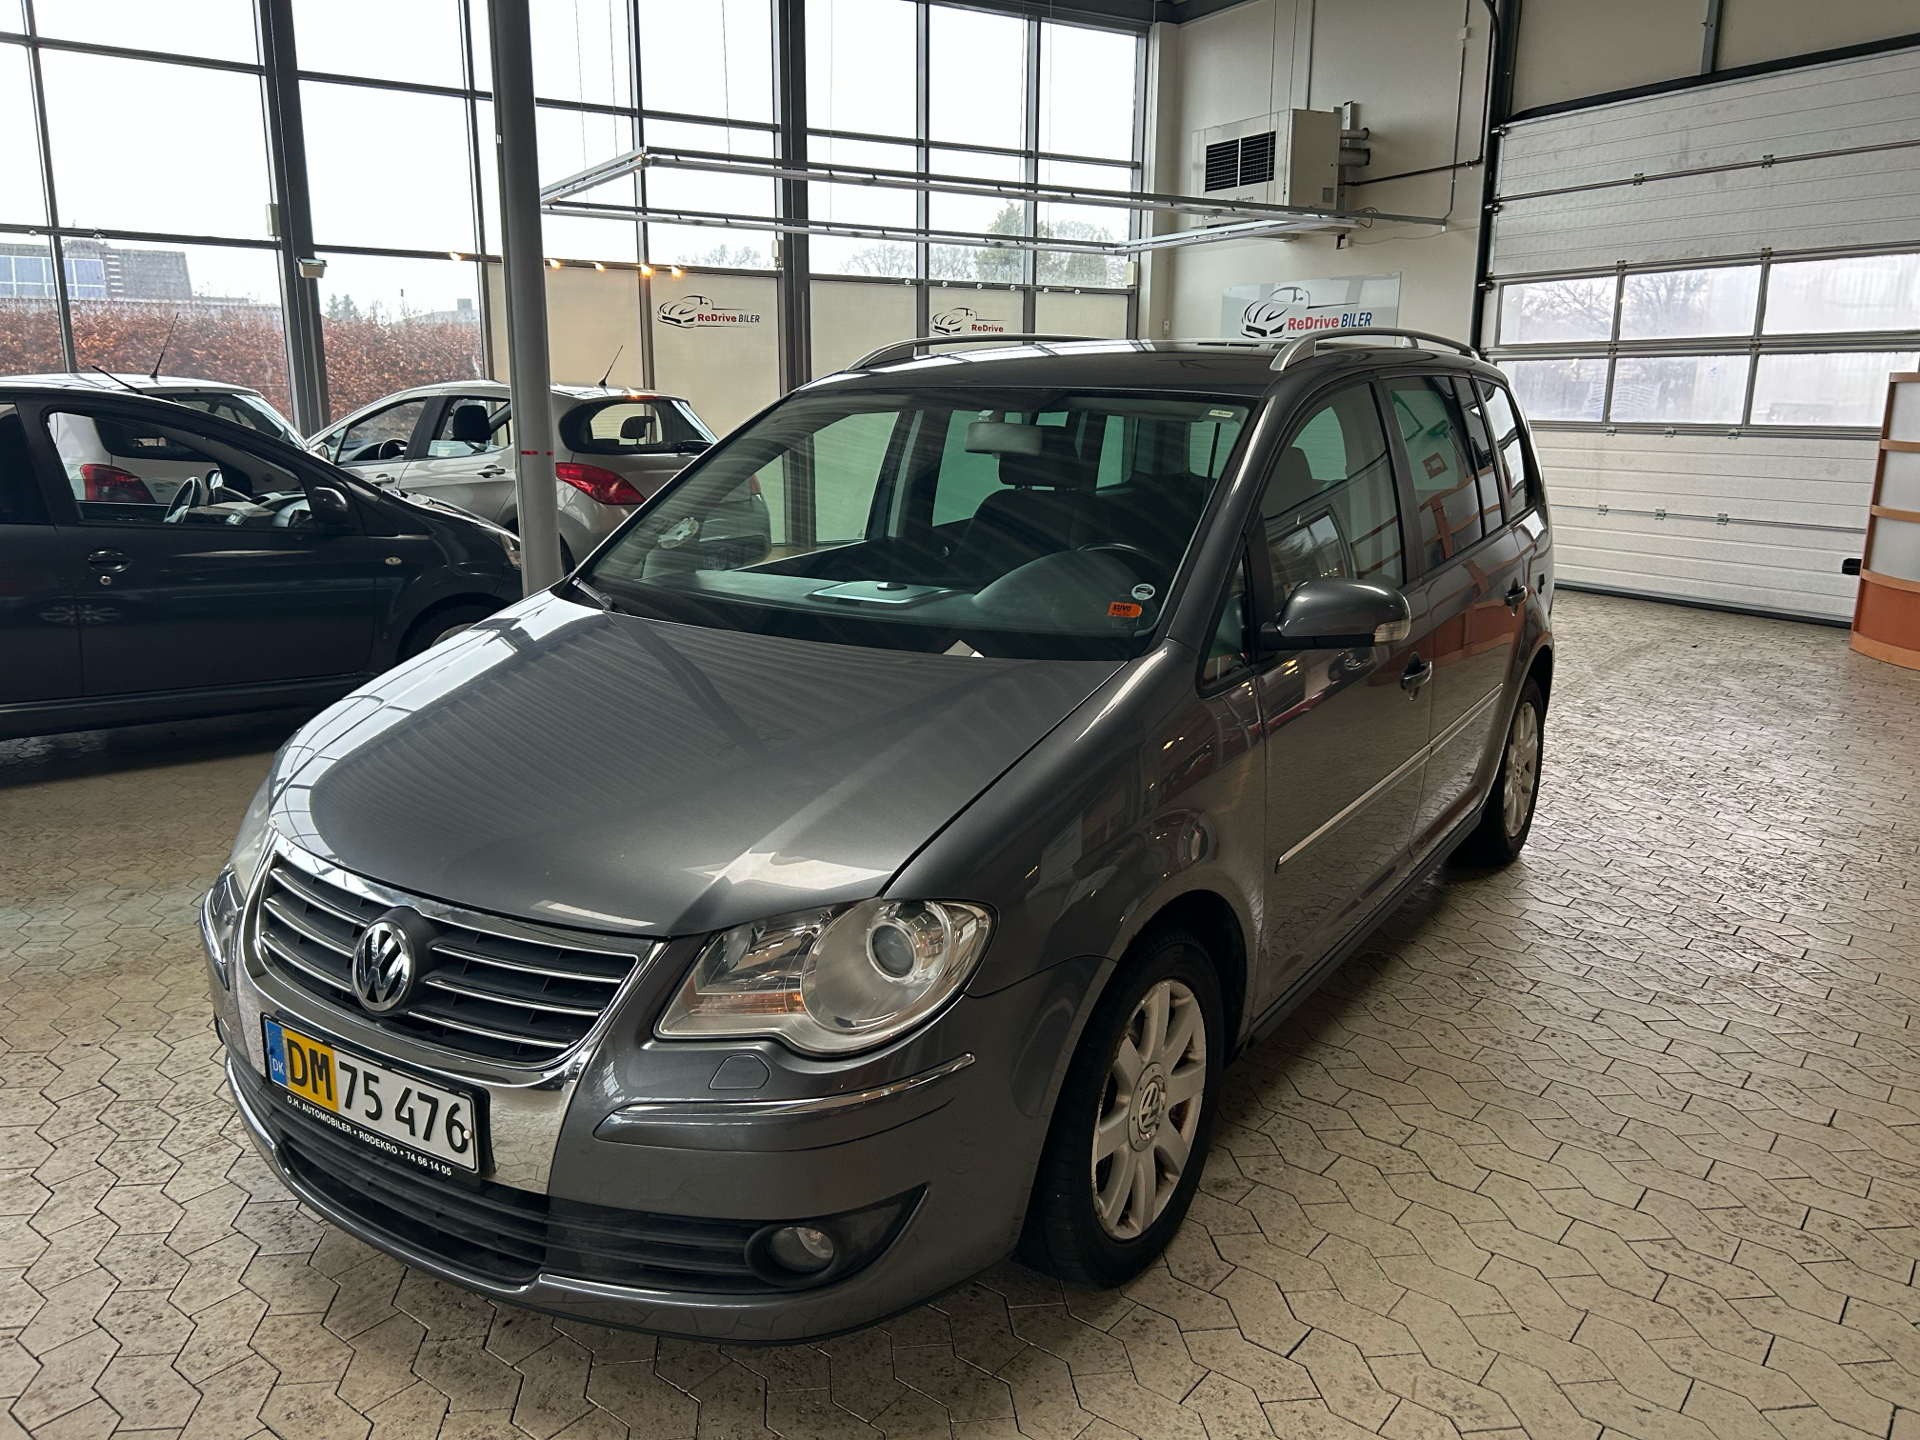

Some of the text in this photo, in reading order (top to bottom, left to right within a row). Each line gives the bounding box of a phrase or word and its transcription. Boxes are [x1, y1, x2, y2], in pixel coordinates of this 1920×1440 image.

[697, 313, 760, 323] ReDrive BILER
[1288, 312, 1372, 331] ReDrive BILER
[971, 324, 1004, 333] ReDrive
[272, 1059, 285, 1076] DK
[287, 1038, 469, 1154] DM 75 476
[302, 1103, 352, 1134] AUTOMOBILER
[359, 1130, 398, 1154] RØDEKRO
[406, 1151, 416, 1162] 74
[418, 1156, 428, 1167] 66
[430, 1161, 440, 1171] 14
[441, 1165, 452, 1176] 05
